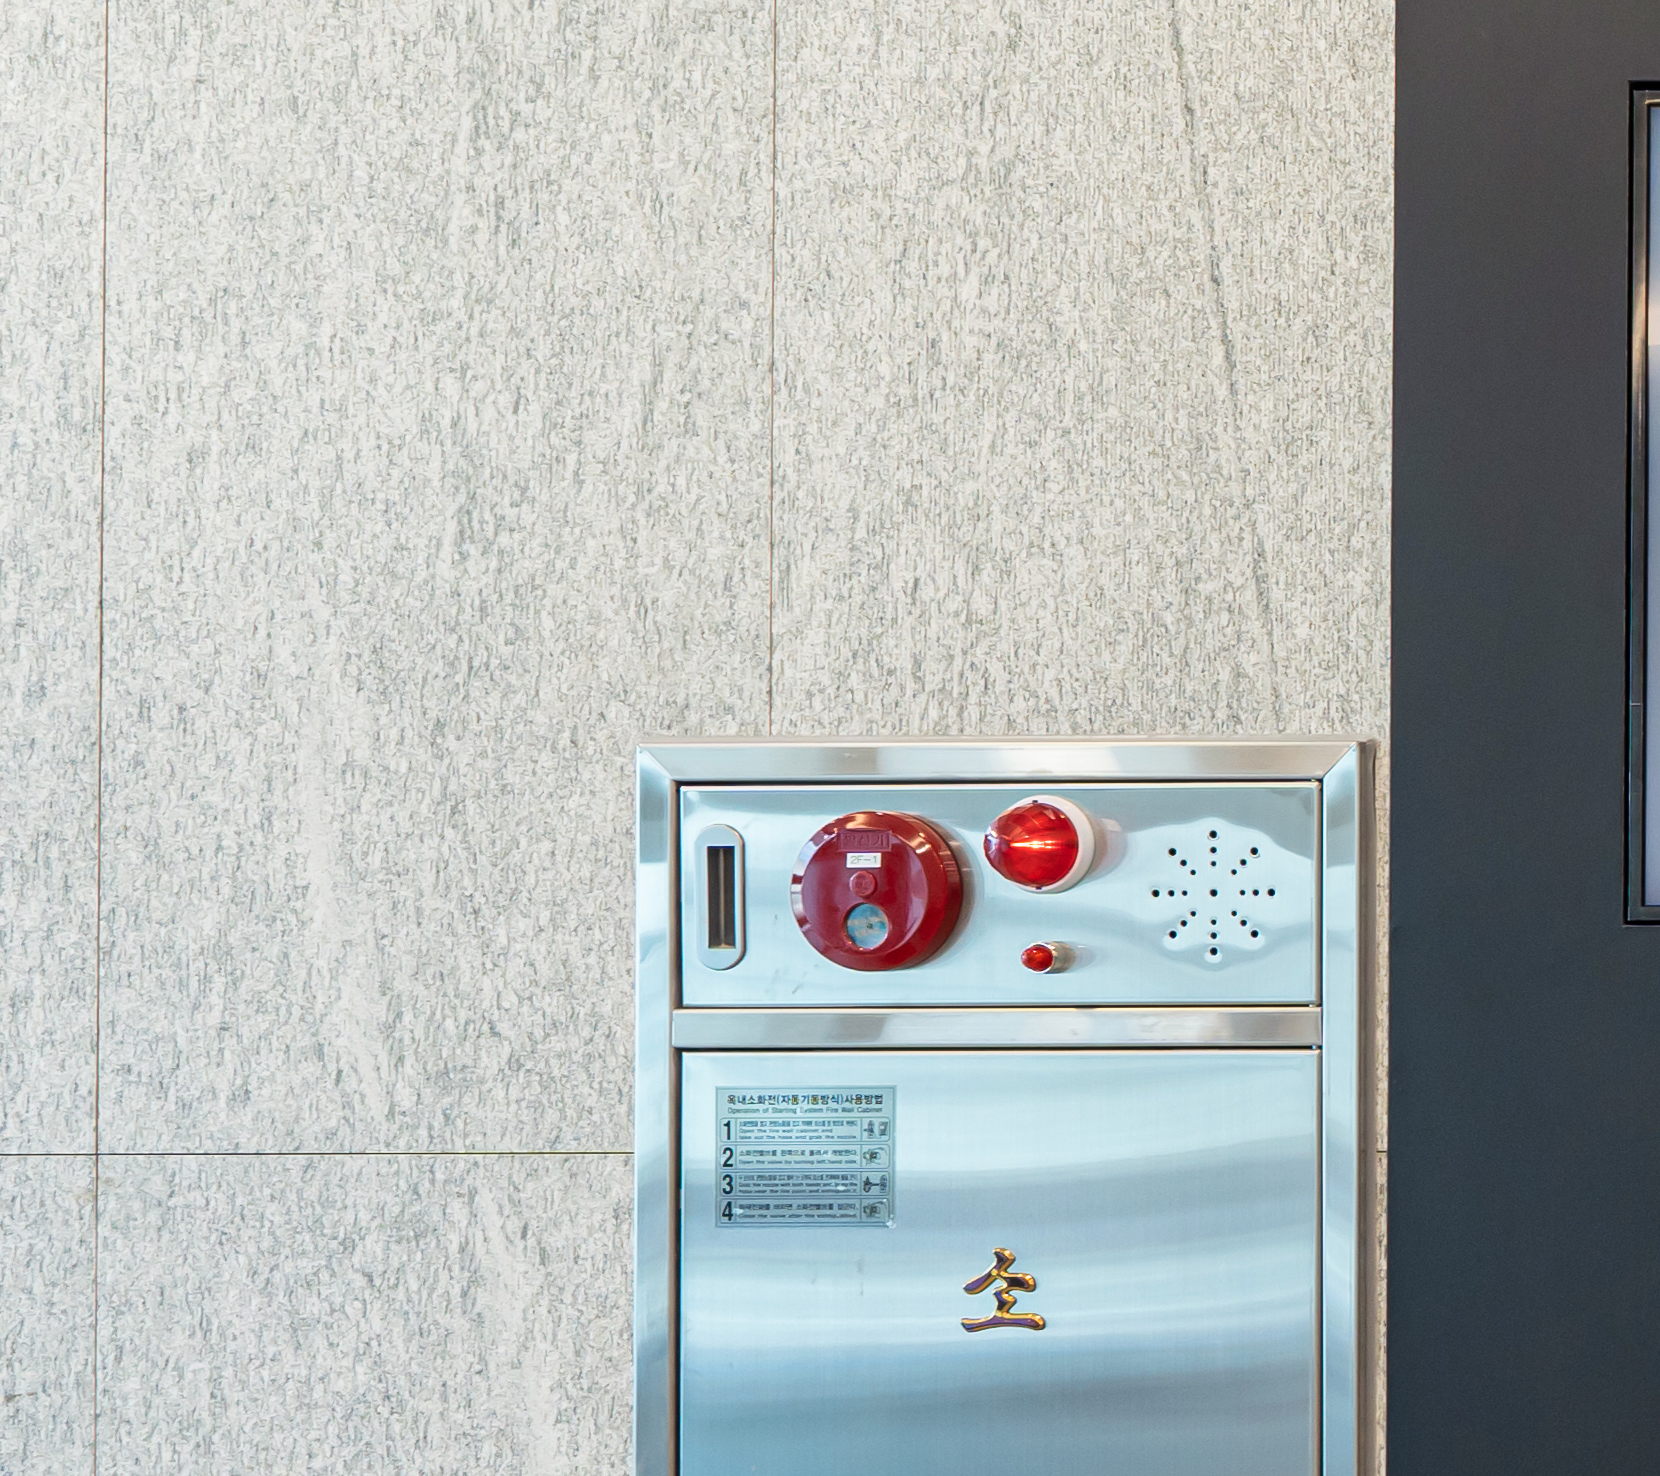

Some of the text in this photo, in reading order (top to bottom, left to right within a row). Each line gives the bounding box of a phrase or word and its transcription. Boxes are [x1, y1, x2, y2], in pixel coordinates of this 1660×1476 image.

[723, 1120, 731, 1140] 1
[722, 1147, 734, 1167] 2
[722, 1174, 734, 1194] 3
[722, 1201, 734, 1221] 4
